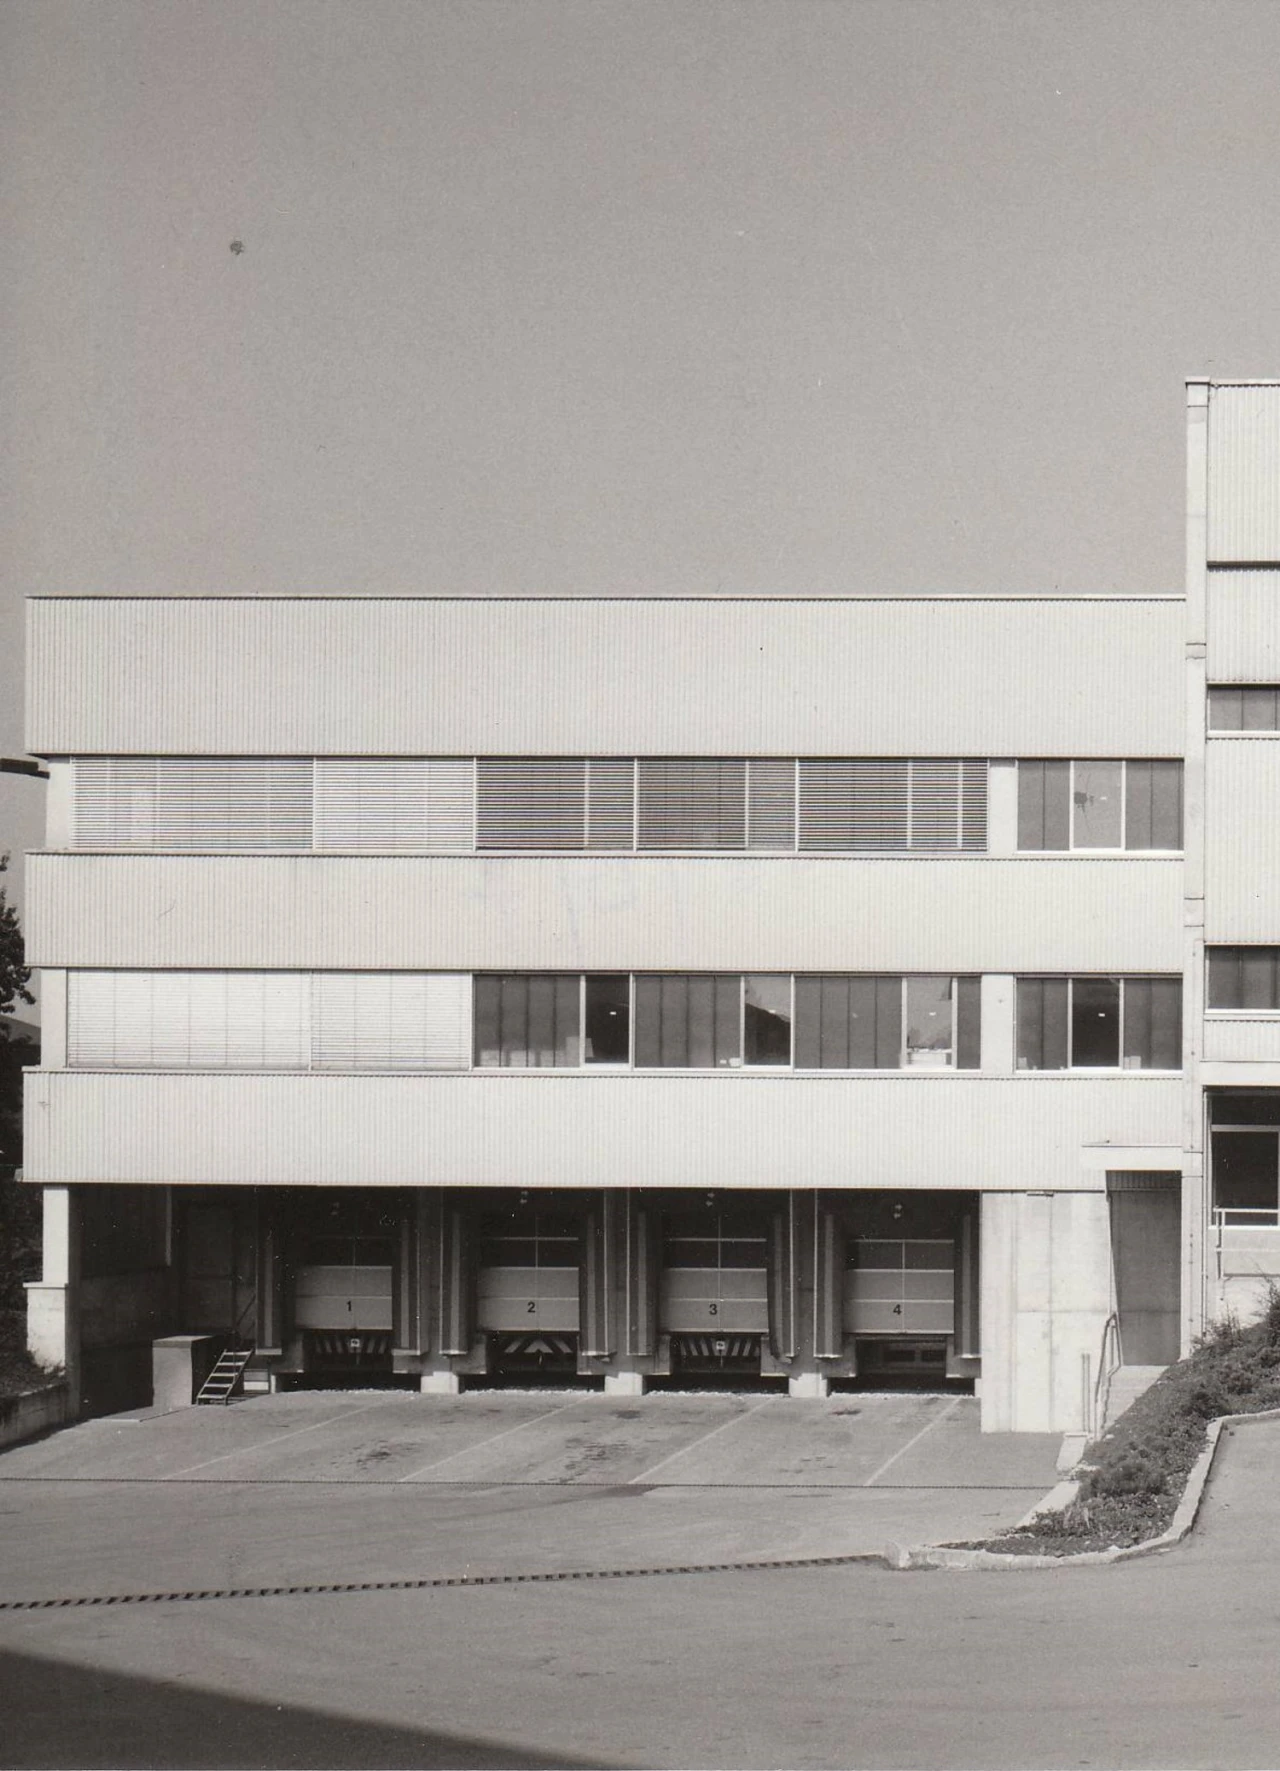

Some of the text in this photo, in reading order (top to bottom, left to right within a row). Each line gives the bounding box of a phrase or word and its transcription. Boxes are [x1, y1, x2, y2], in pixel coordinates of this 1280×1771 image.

[527, 1301, 537, 1313] 2
[708, 1303, 718, 1316] 3
[892, 1303, 903, 1316] 4
